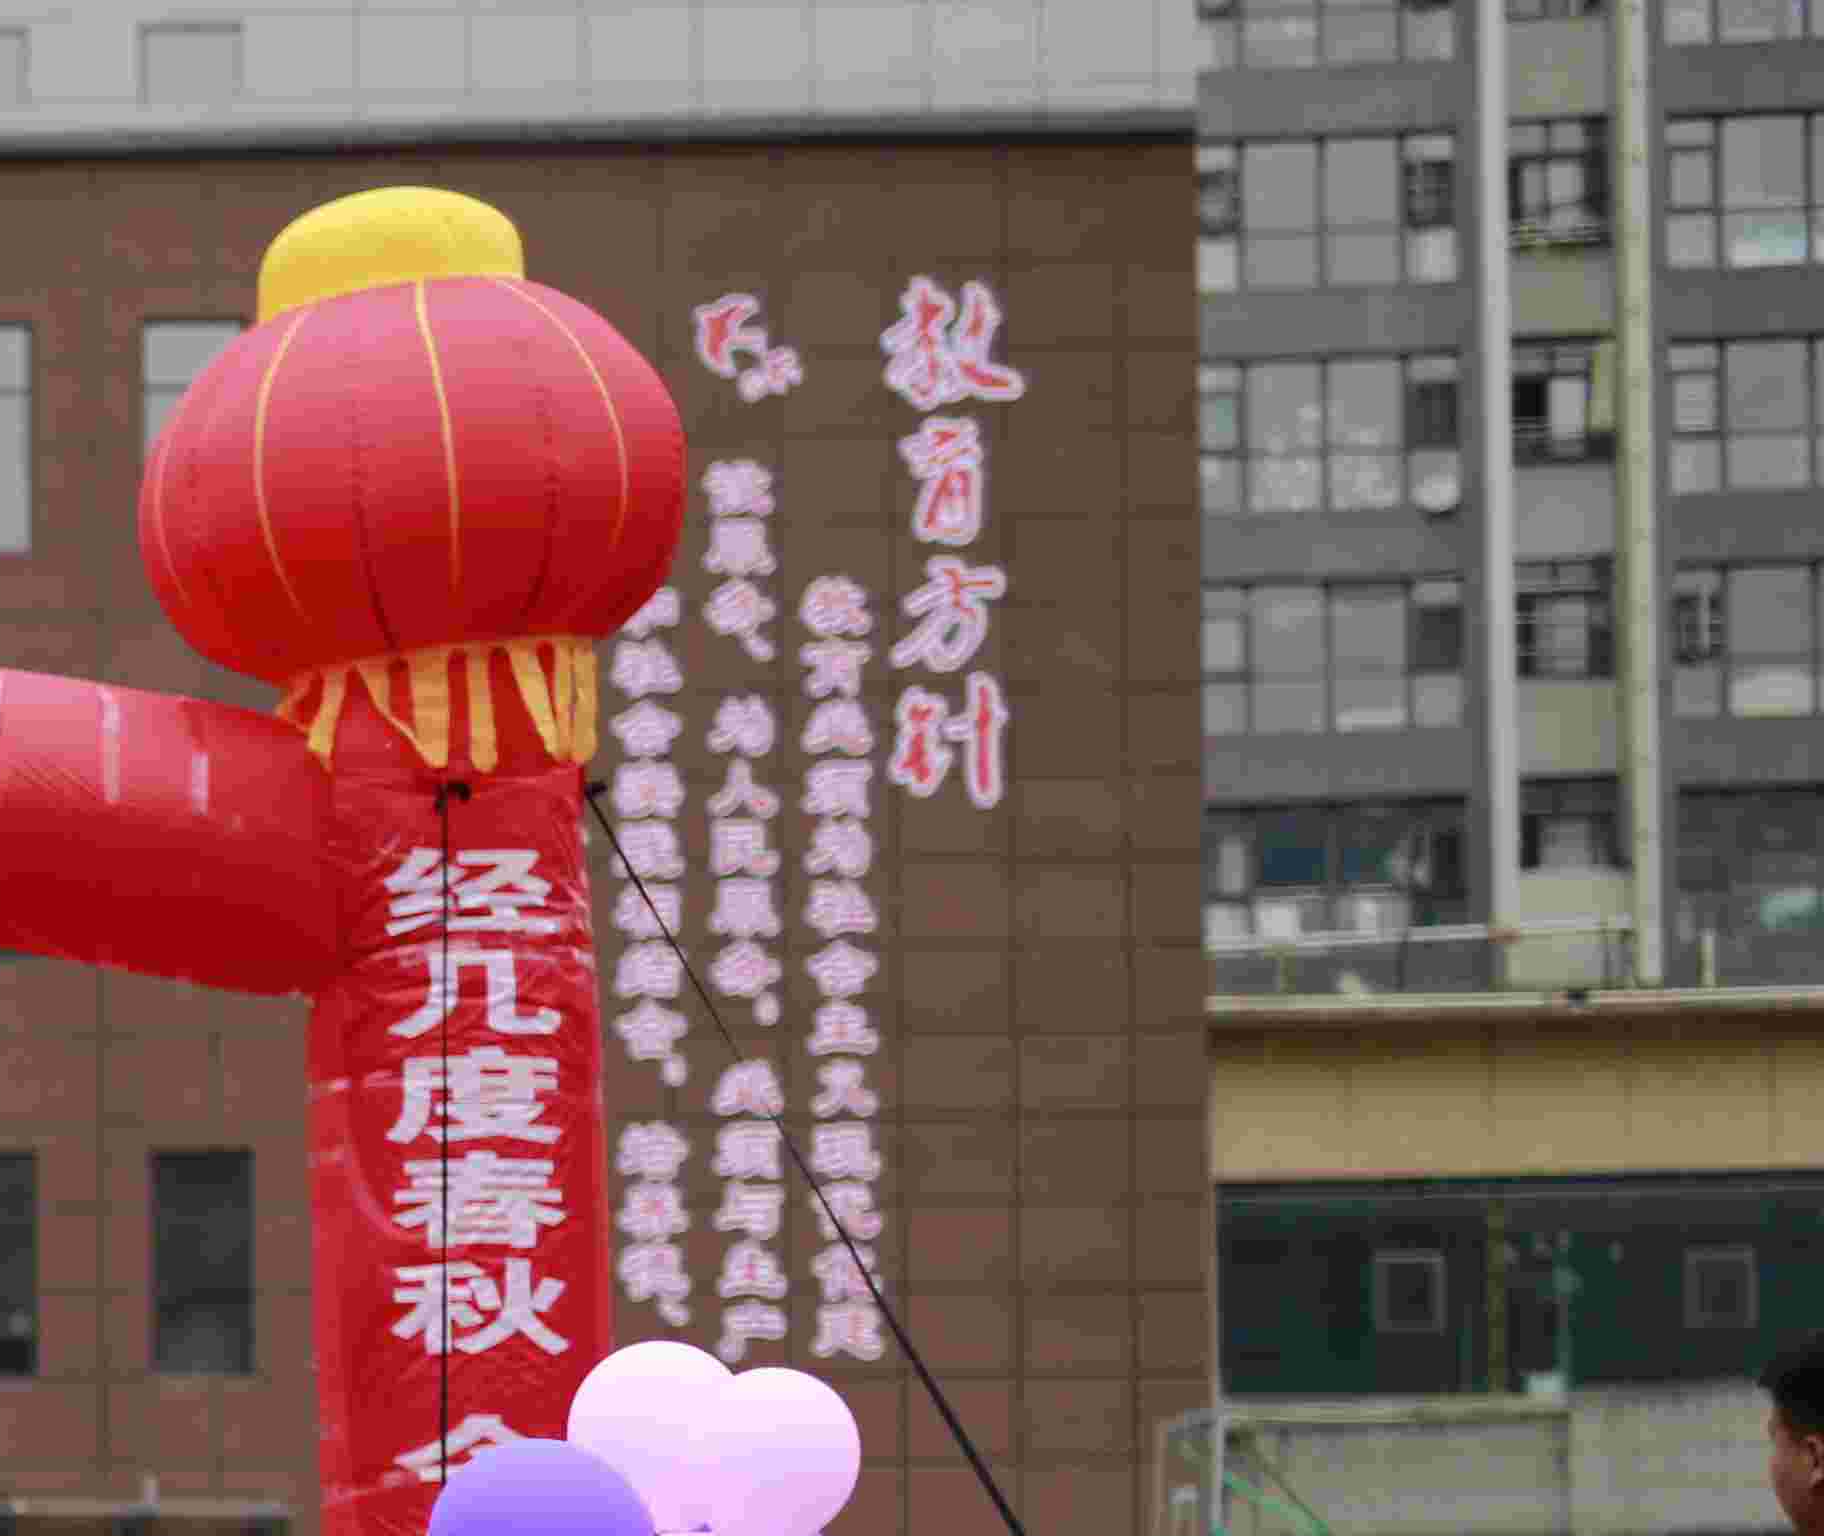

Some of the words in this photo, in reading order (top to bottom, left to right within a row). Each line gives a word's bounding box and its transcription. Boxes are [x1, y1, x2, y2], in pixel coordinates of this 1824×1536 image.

[881, 275, 1025, 809] 教育方针
[384, 847, 570, 1355] 经几度春秋
